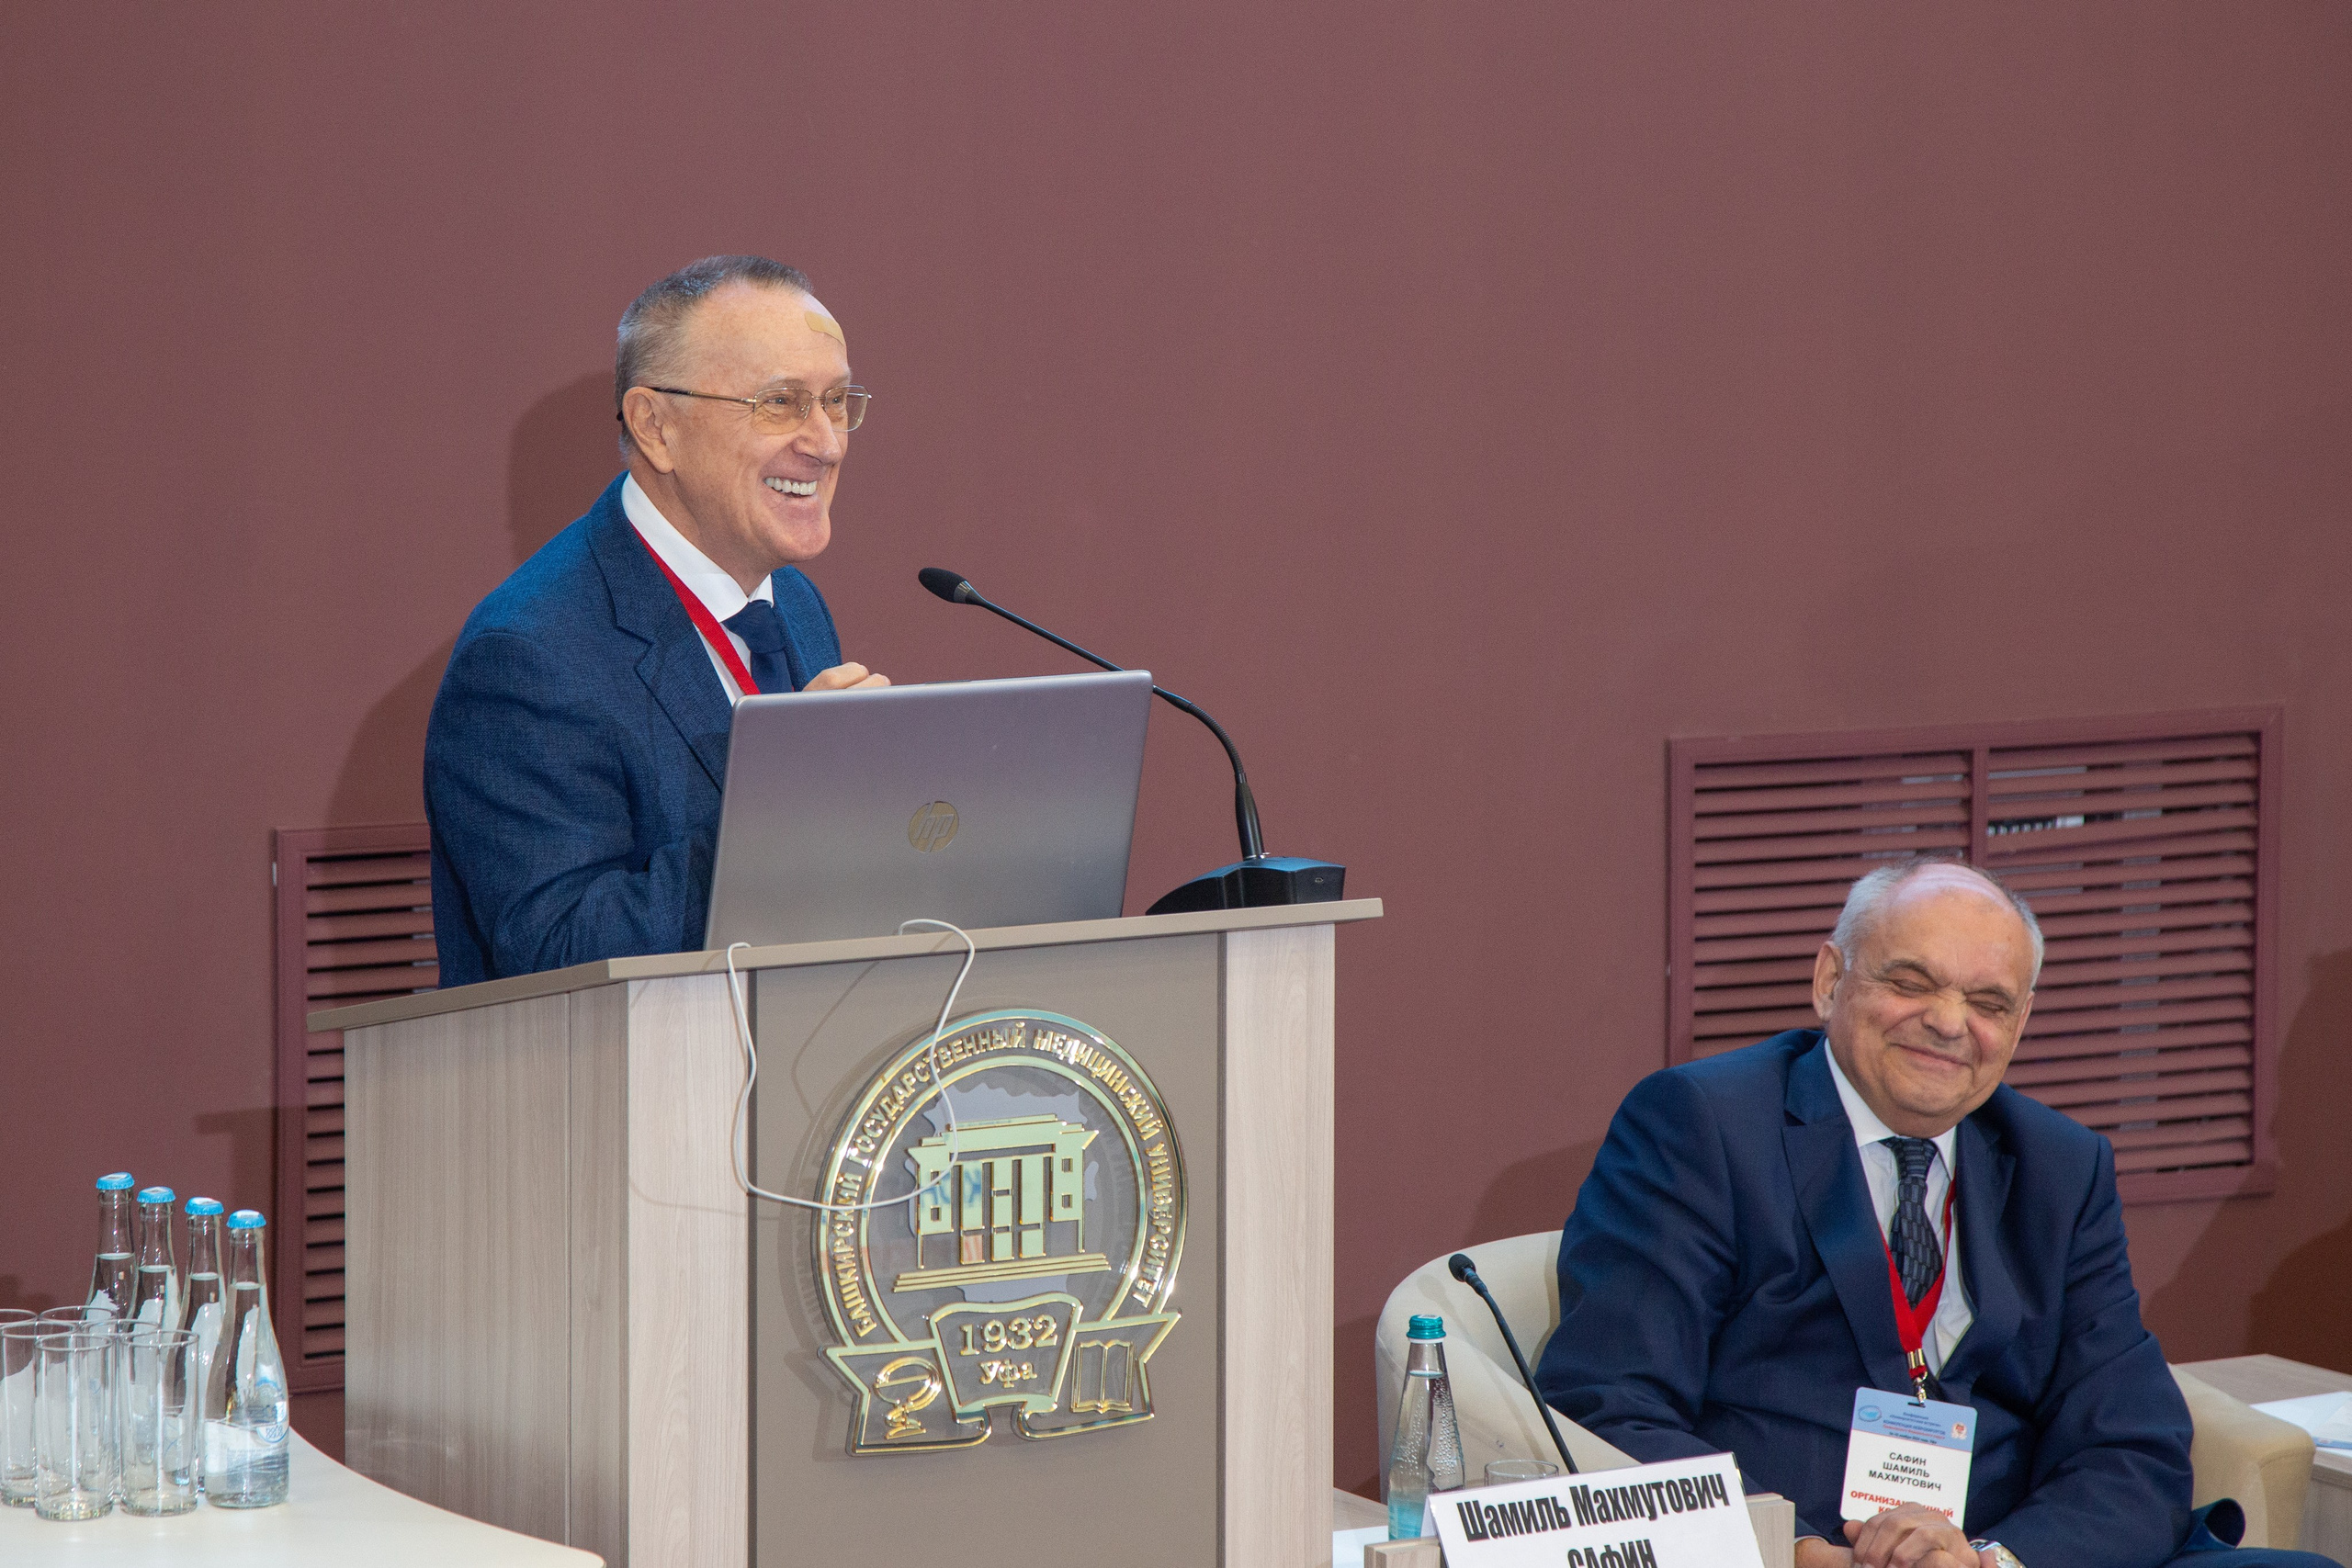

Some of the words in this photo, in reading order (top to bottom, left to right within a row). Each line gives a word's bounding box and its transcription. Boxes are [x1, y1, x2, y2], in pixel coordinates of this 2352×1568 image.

[910, 802, 956, 852] hp
[845, 1021, 1027, 1168] ГОСУДАРСТВЕННЫЙ
[1033, 1028, 1163, 1141] МЕДИЦИНСКИЙ
[1132, 1141, 1173, 1308] УНИВЕРСИТЕТ
[833, 1172, 877, 1337] БАШКИРСКИЙ
[959, 1314, 1058, 1357] 1932
[978, 1359, 1038, 1389] Уфа
[1868, 1470, 1941, 1491] МАХМУТОВИЧ
[1883, 1461, 1930, 1479] ШАМИЛЬ
[1889, 1451, 1927, 1467] САФИН
[1455, 1495, 1572, 1543] Шамиль
[1568, 1472, 1731, 1527] Махмутович
